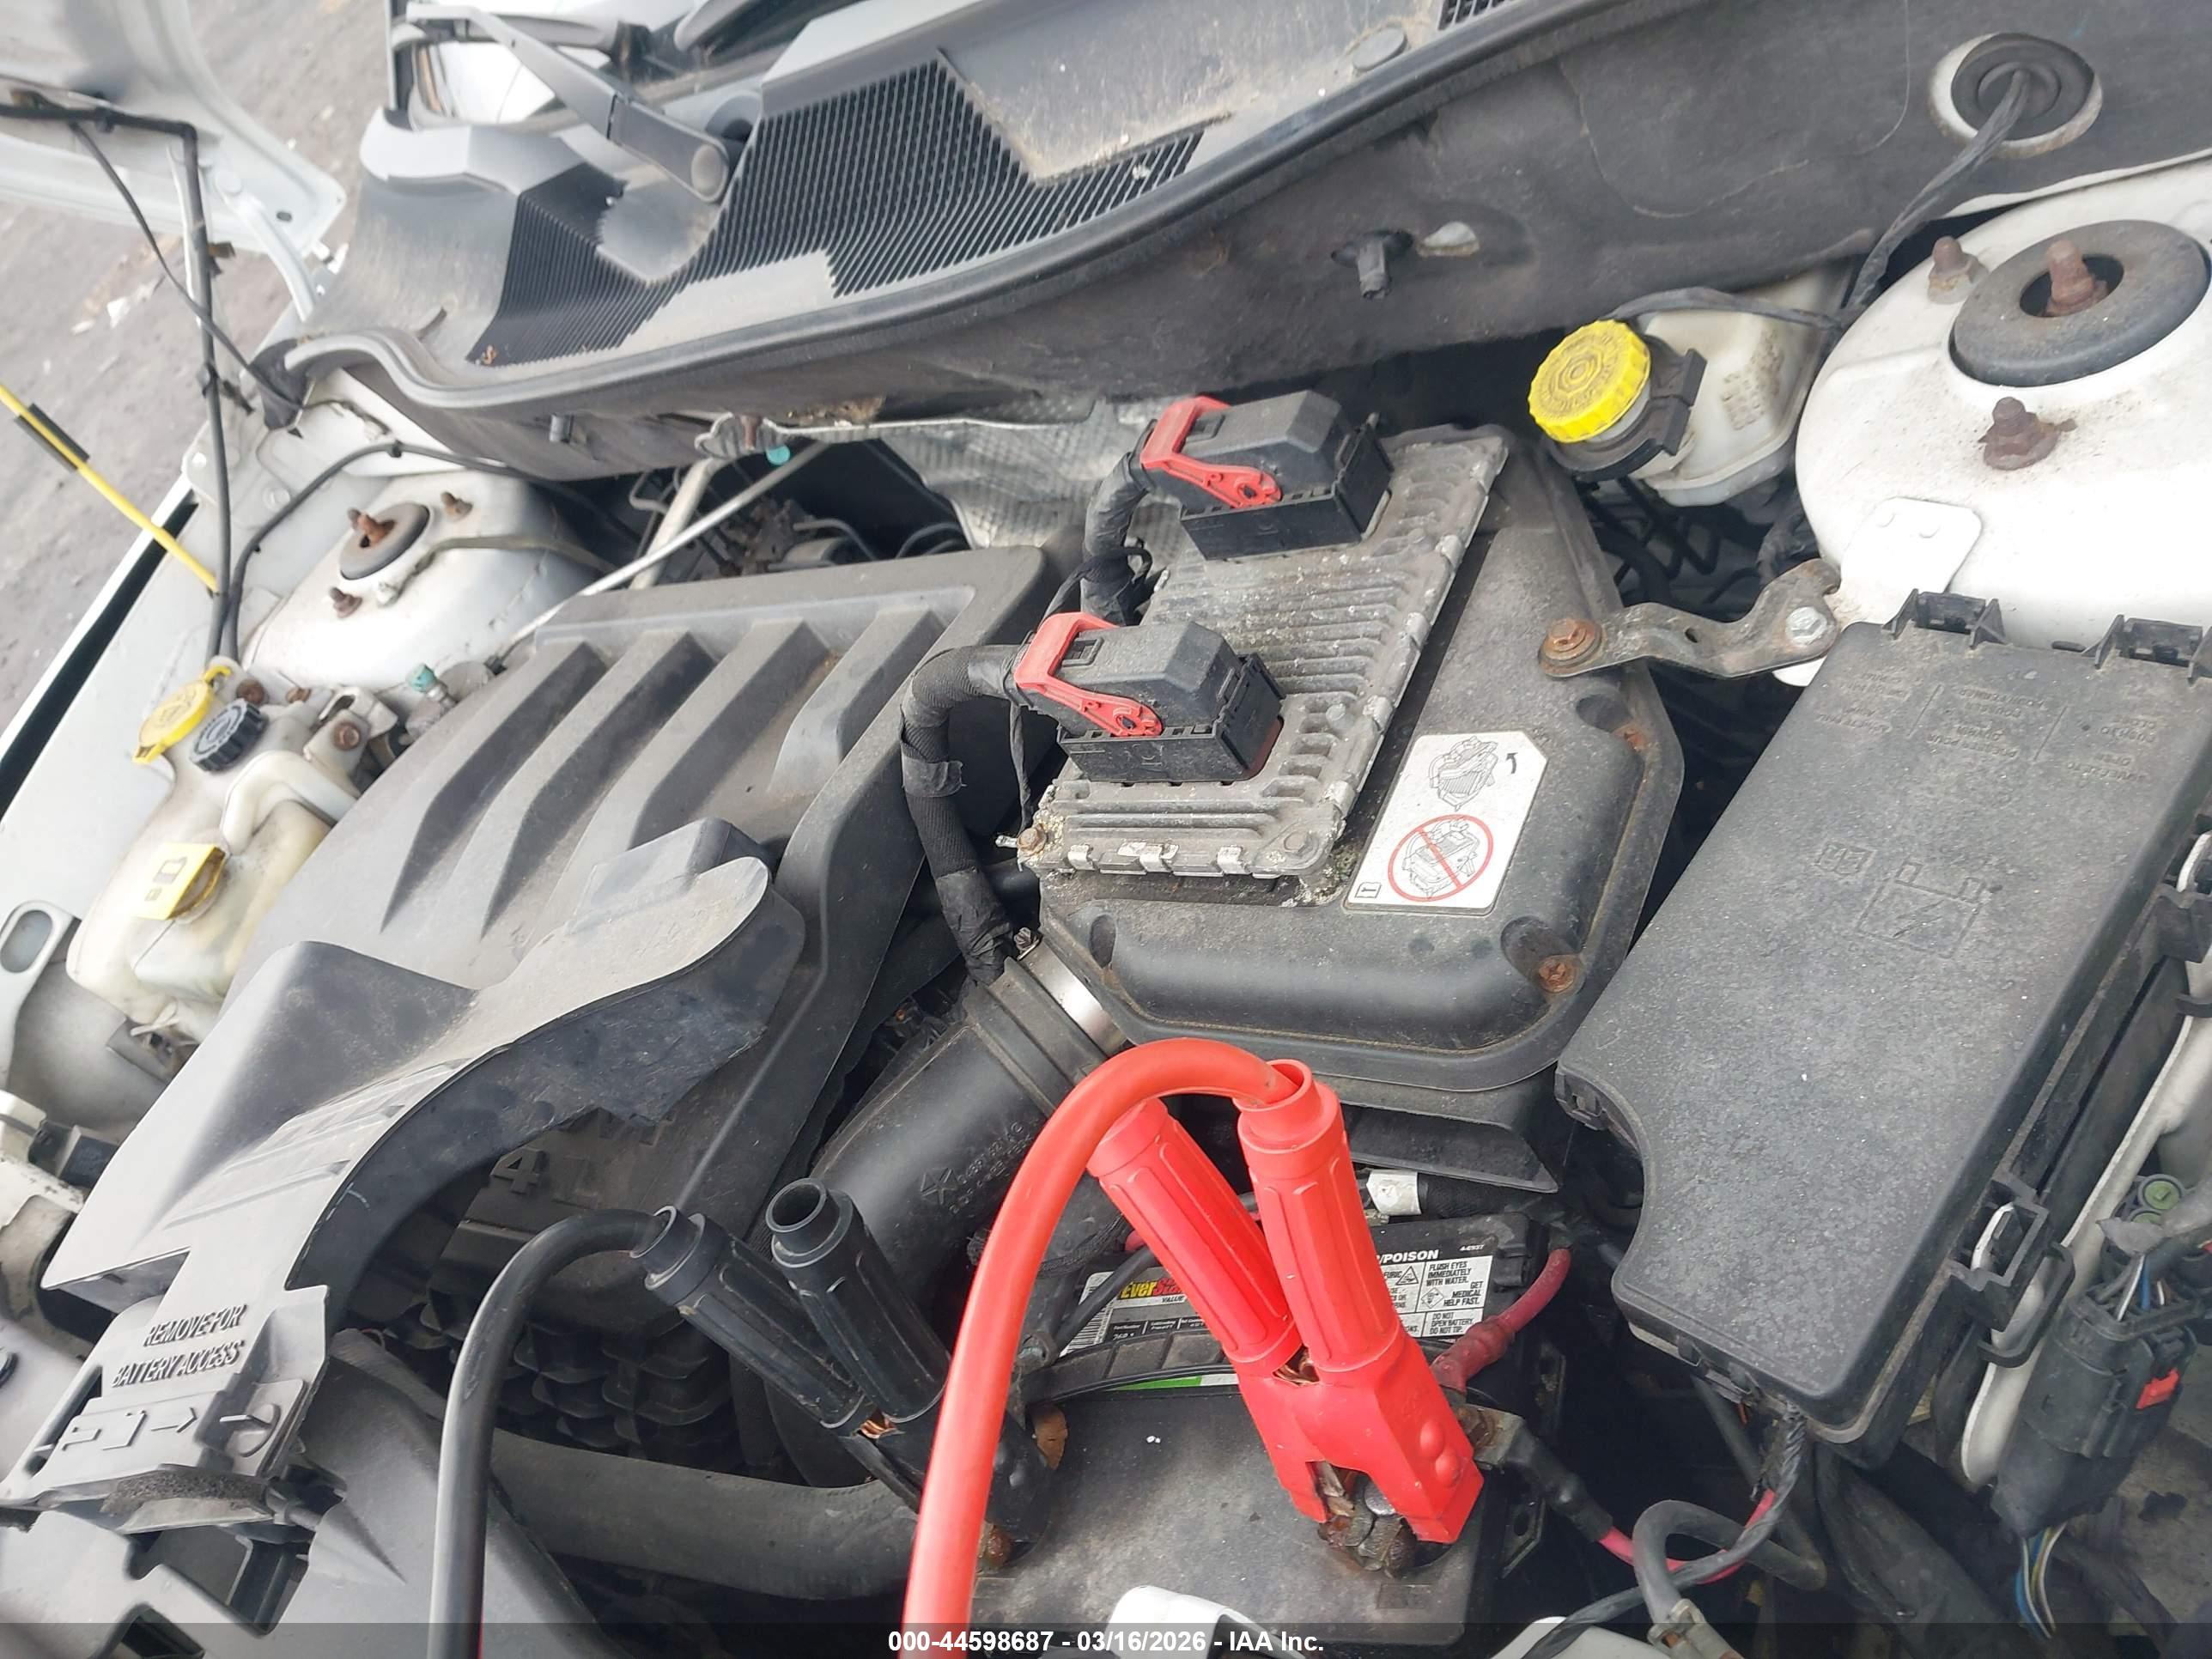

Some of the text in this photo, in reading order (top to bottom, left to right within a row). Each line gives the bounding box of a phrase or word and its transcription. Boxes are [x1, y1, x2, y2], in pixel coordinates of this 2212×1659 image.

[1429, 1261, 1468, 1271] FLUSH EYES
[1427, 1268, 1472, 1279] IMMEDIATELY
[1426, 1278, 1443, 1287] WITH
[1470, 1280, 1484, 1289] GET
[1452, 1289, 1482, 1298] MEDICAL
[1443, 1297, 1461, 1306] HELP
[1432, 1311, 1455, 1321] DO NOT
[143, 1303, 249, 1348] REMOVE FOR
[1431, 1320, 1448, 1328] OPEN
[1429, 1327, 1439, 1335] DO
[1439, 1326, 1452, 1334] NOT
[111, 1339, 246, 1389] BATTERY ACCESS
